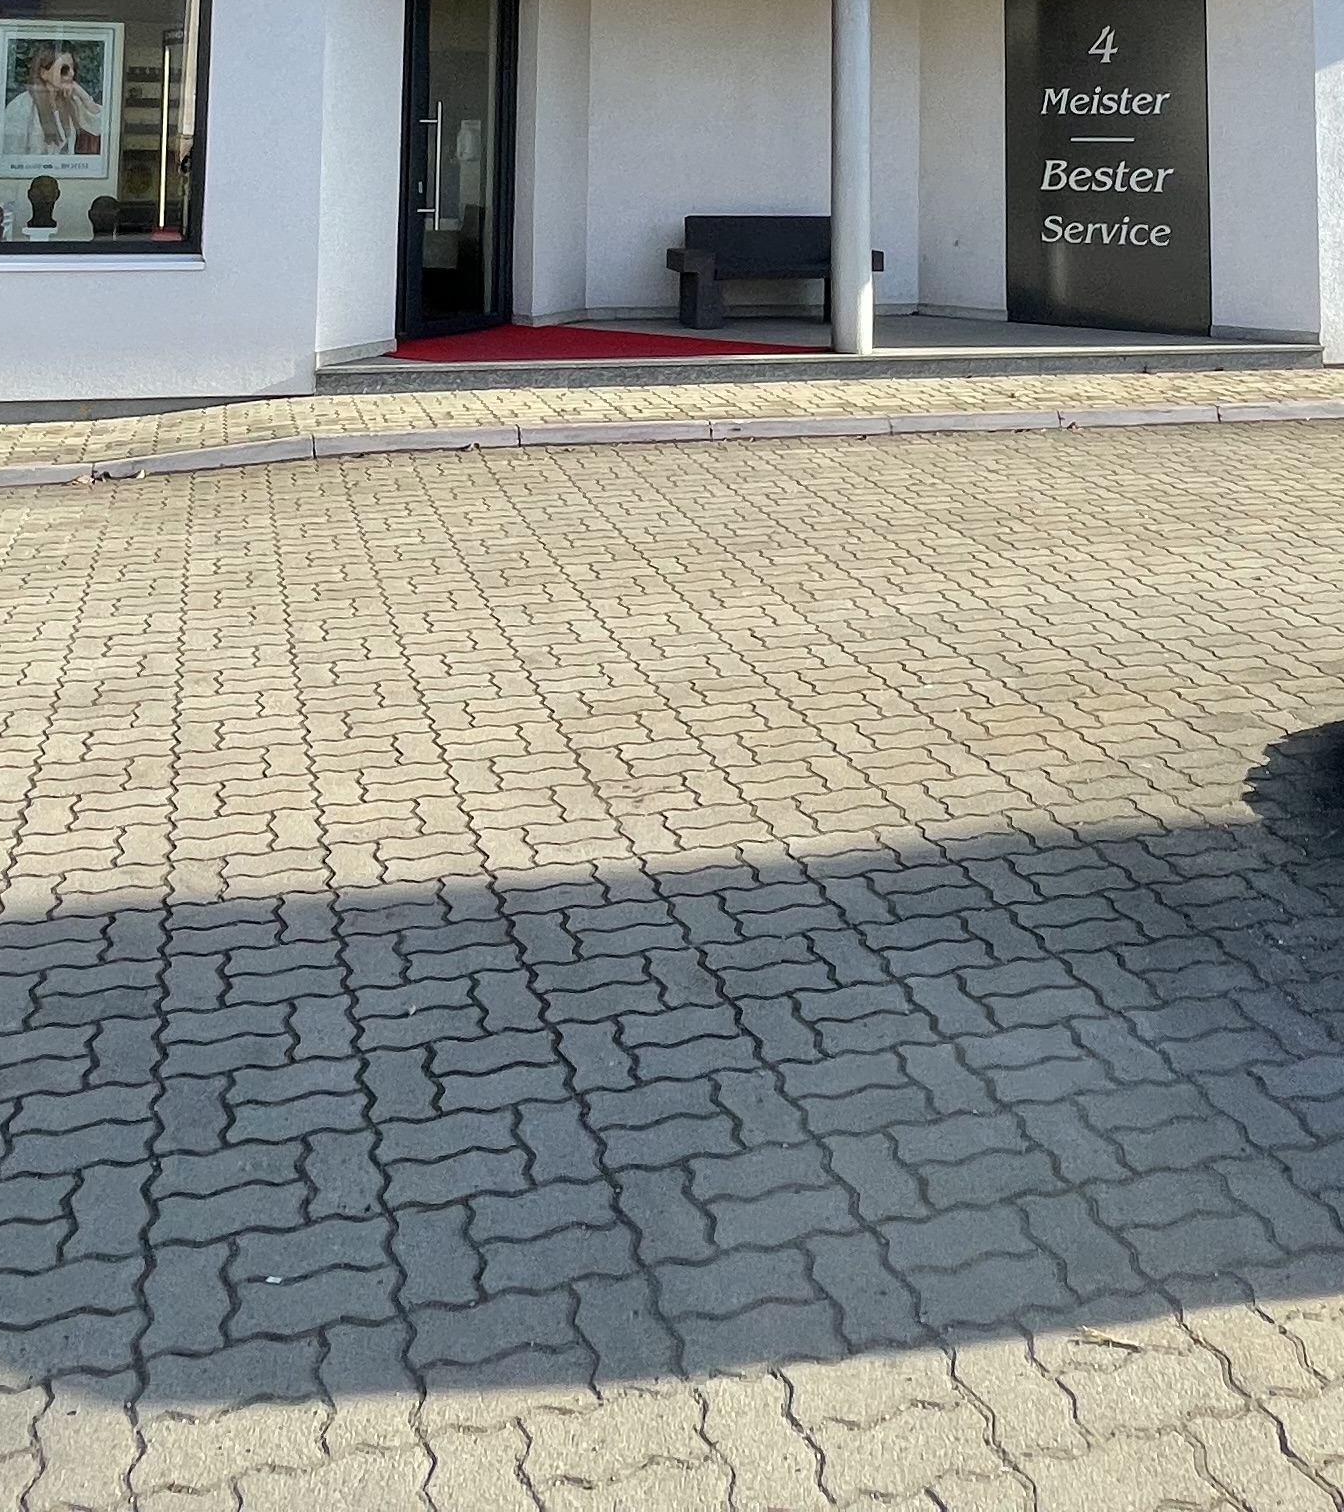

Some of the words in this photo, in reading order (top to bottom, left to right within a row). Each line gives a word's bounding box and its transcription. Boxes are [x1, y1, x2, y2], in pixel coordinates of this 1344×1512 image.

[1088, 24, 1119, 64] 4
[1040, 85, 1171, 117] Meister
[1040, 158, 1175, 194] Bester
[1040, 214, 1172, 248] Service
